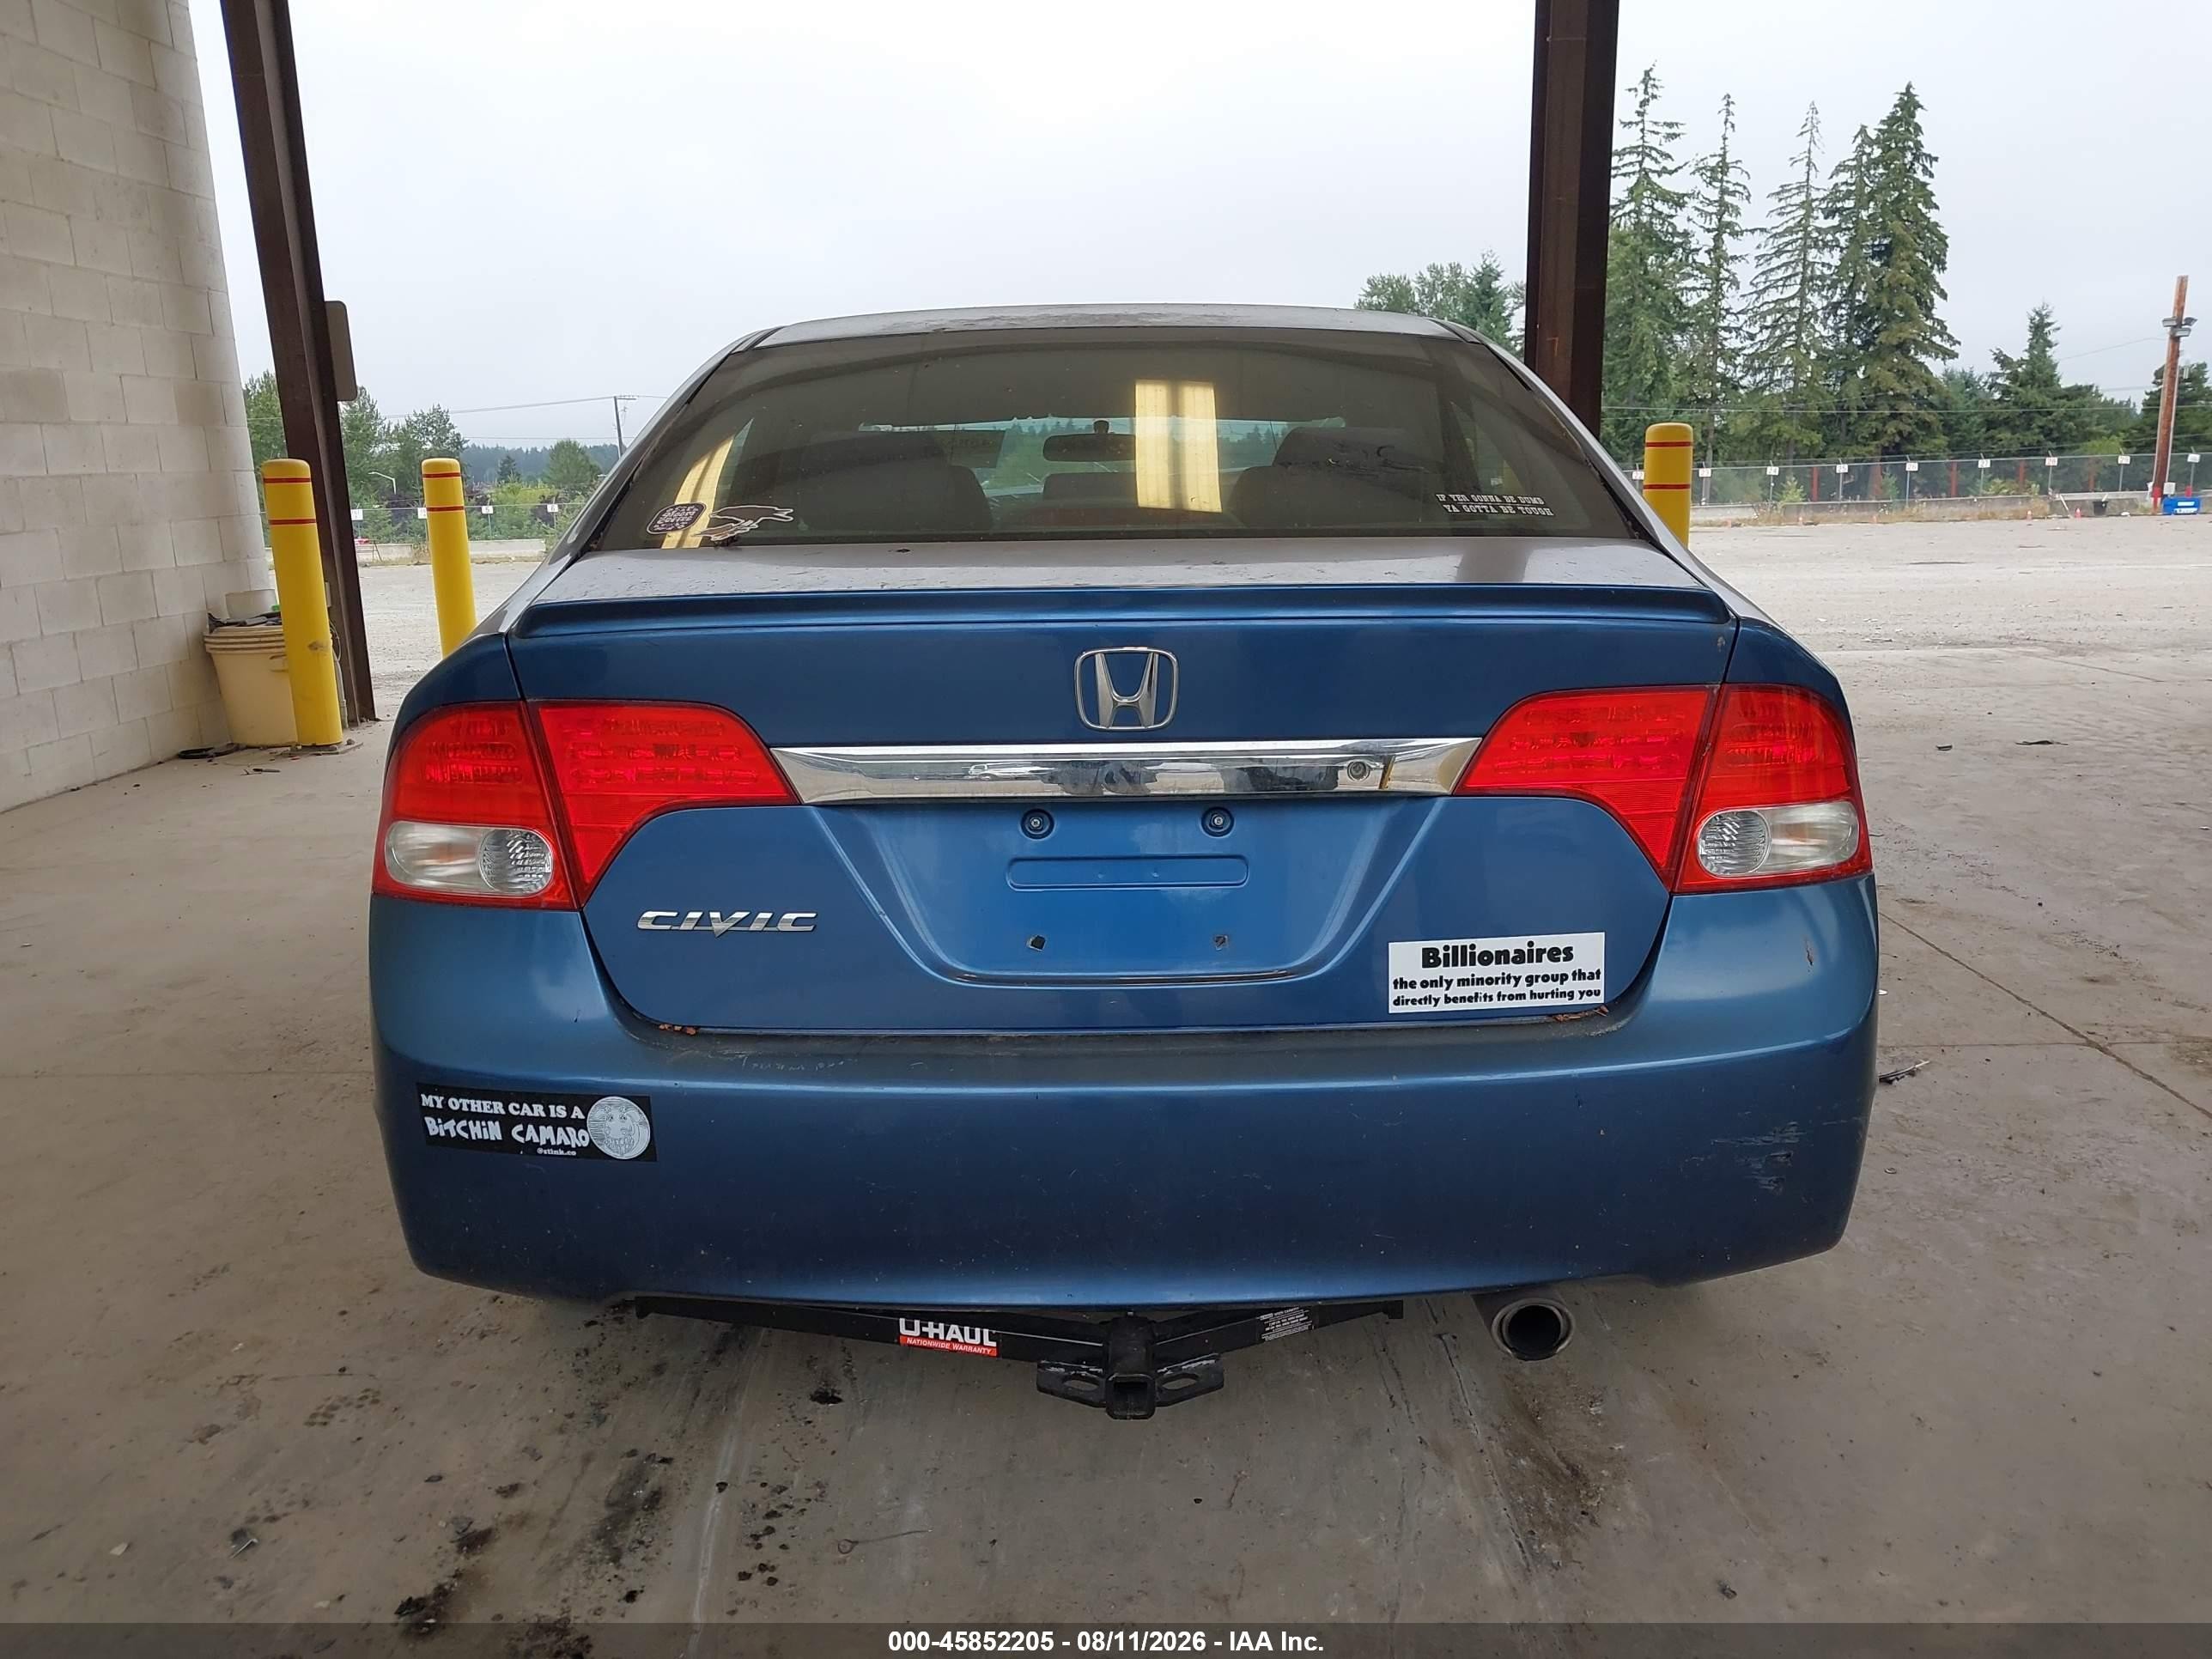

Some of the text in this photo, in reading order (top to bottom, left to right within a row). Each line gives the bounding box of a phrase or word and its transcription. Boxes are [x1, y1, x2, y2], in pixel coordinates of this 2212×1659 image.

[1443, 504, 1554, 516] YA GOTTA BE TOUGH
[1470, 494, 1503, 502] GONNA
[1516, 495, 1545, 505] DUMB
[637, 910, 817, 939] CIVIC
[1421, 941, 1574, 969] Billionaires
[1393, 969, 1601, 991] the only minority group that
[1393, 988, 1601, 1007] directly benefits from hurting you
[421, 1094, 586, 1120] MY OTHER CAR IS A
[511, 1123, 590, 1148] CAMARO
[899, 1317, 997, 1347] U-HAUL
[906, 1337, 992, 1355] NATIONWIDE WARRANTY
